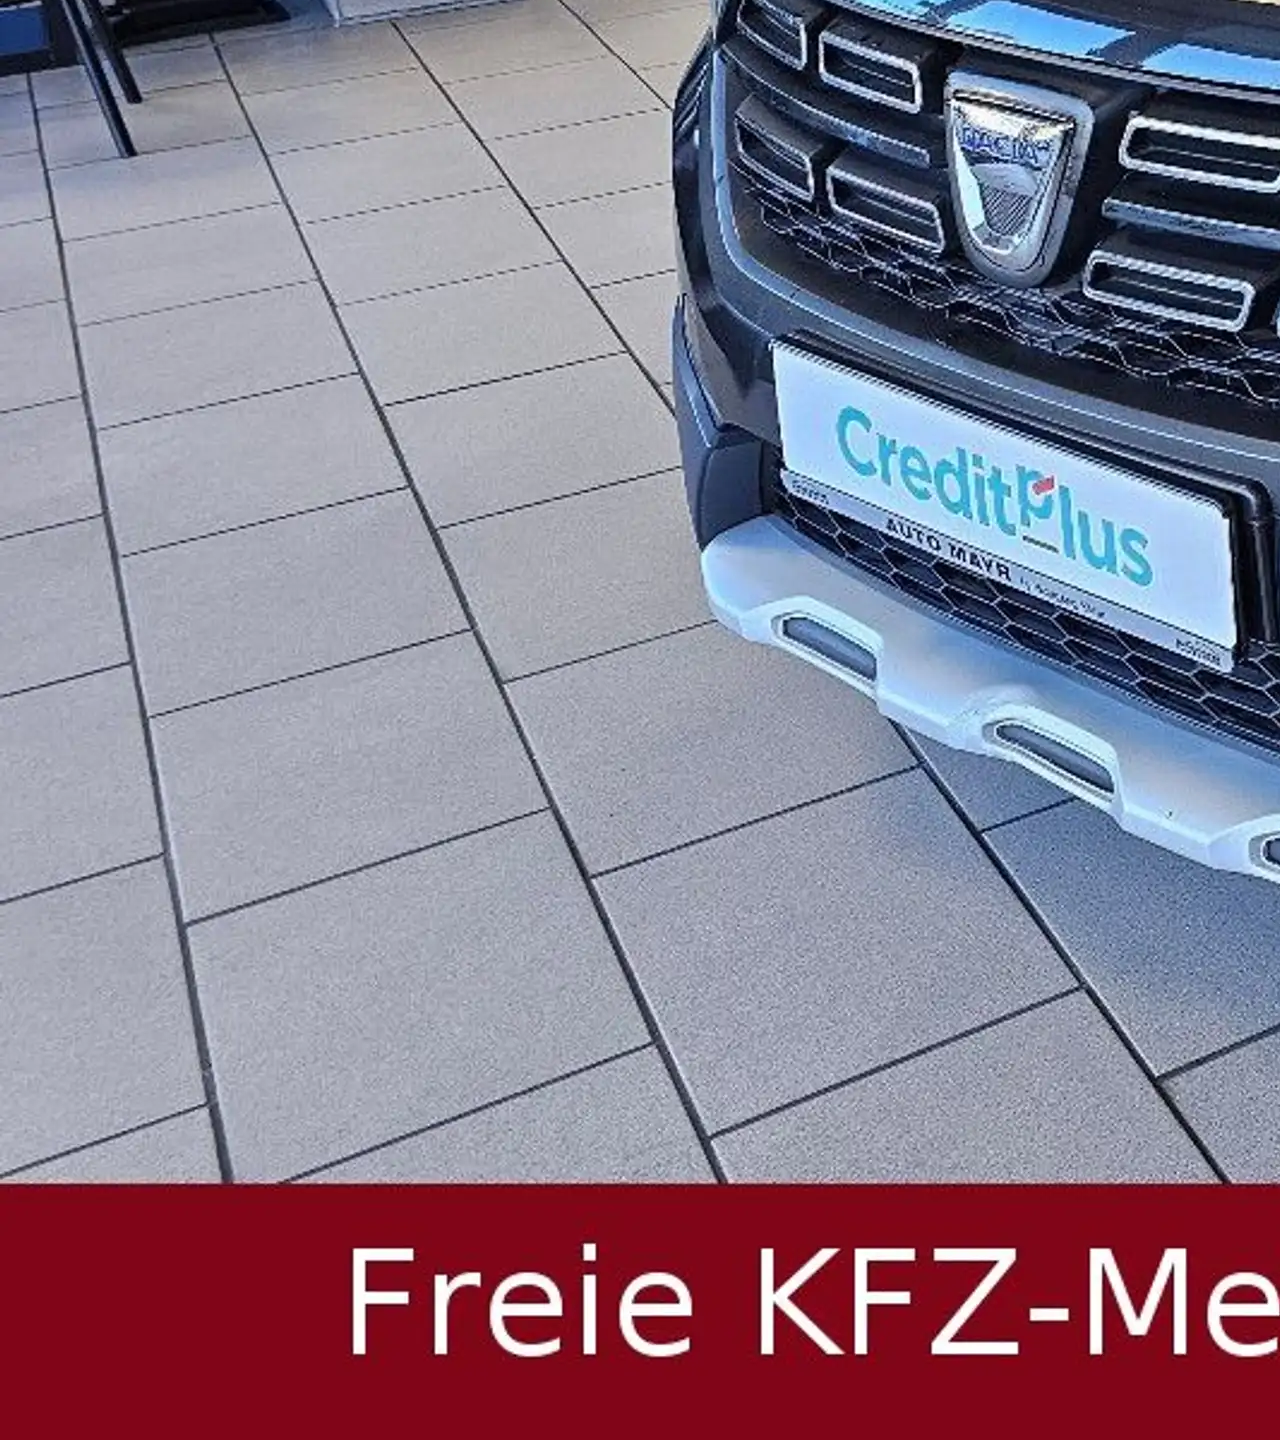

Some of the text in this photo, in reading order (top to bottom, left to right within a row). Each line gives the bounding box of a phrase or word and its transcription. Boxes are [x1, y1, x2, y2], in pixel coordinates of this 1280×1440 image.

[836, 405, 1153, 587] CreditPlus
[886, 518, 941, 551] AUTO
[947, 542, 1012, 581] MAYR
